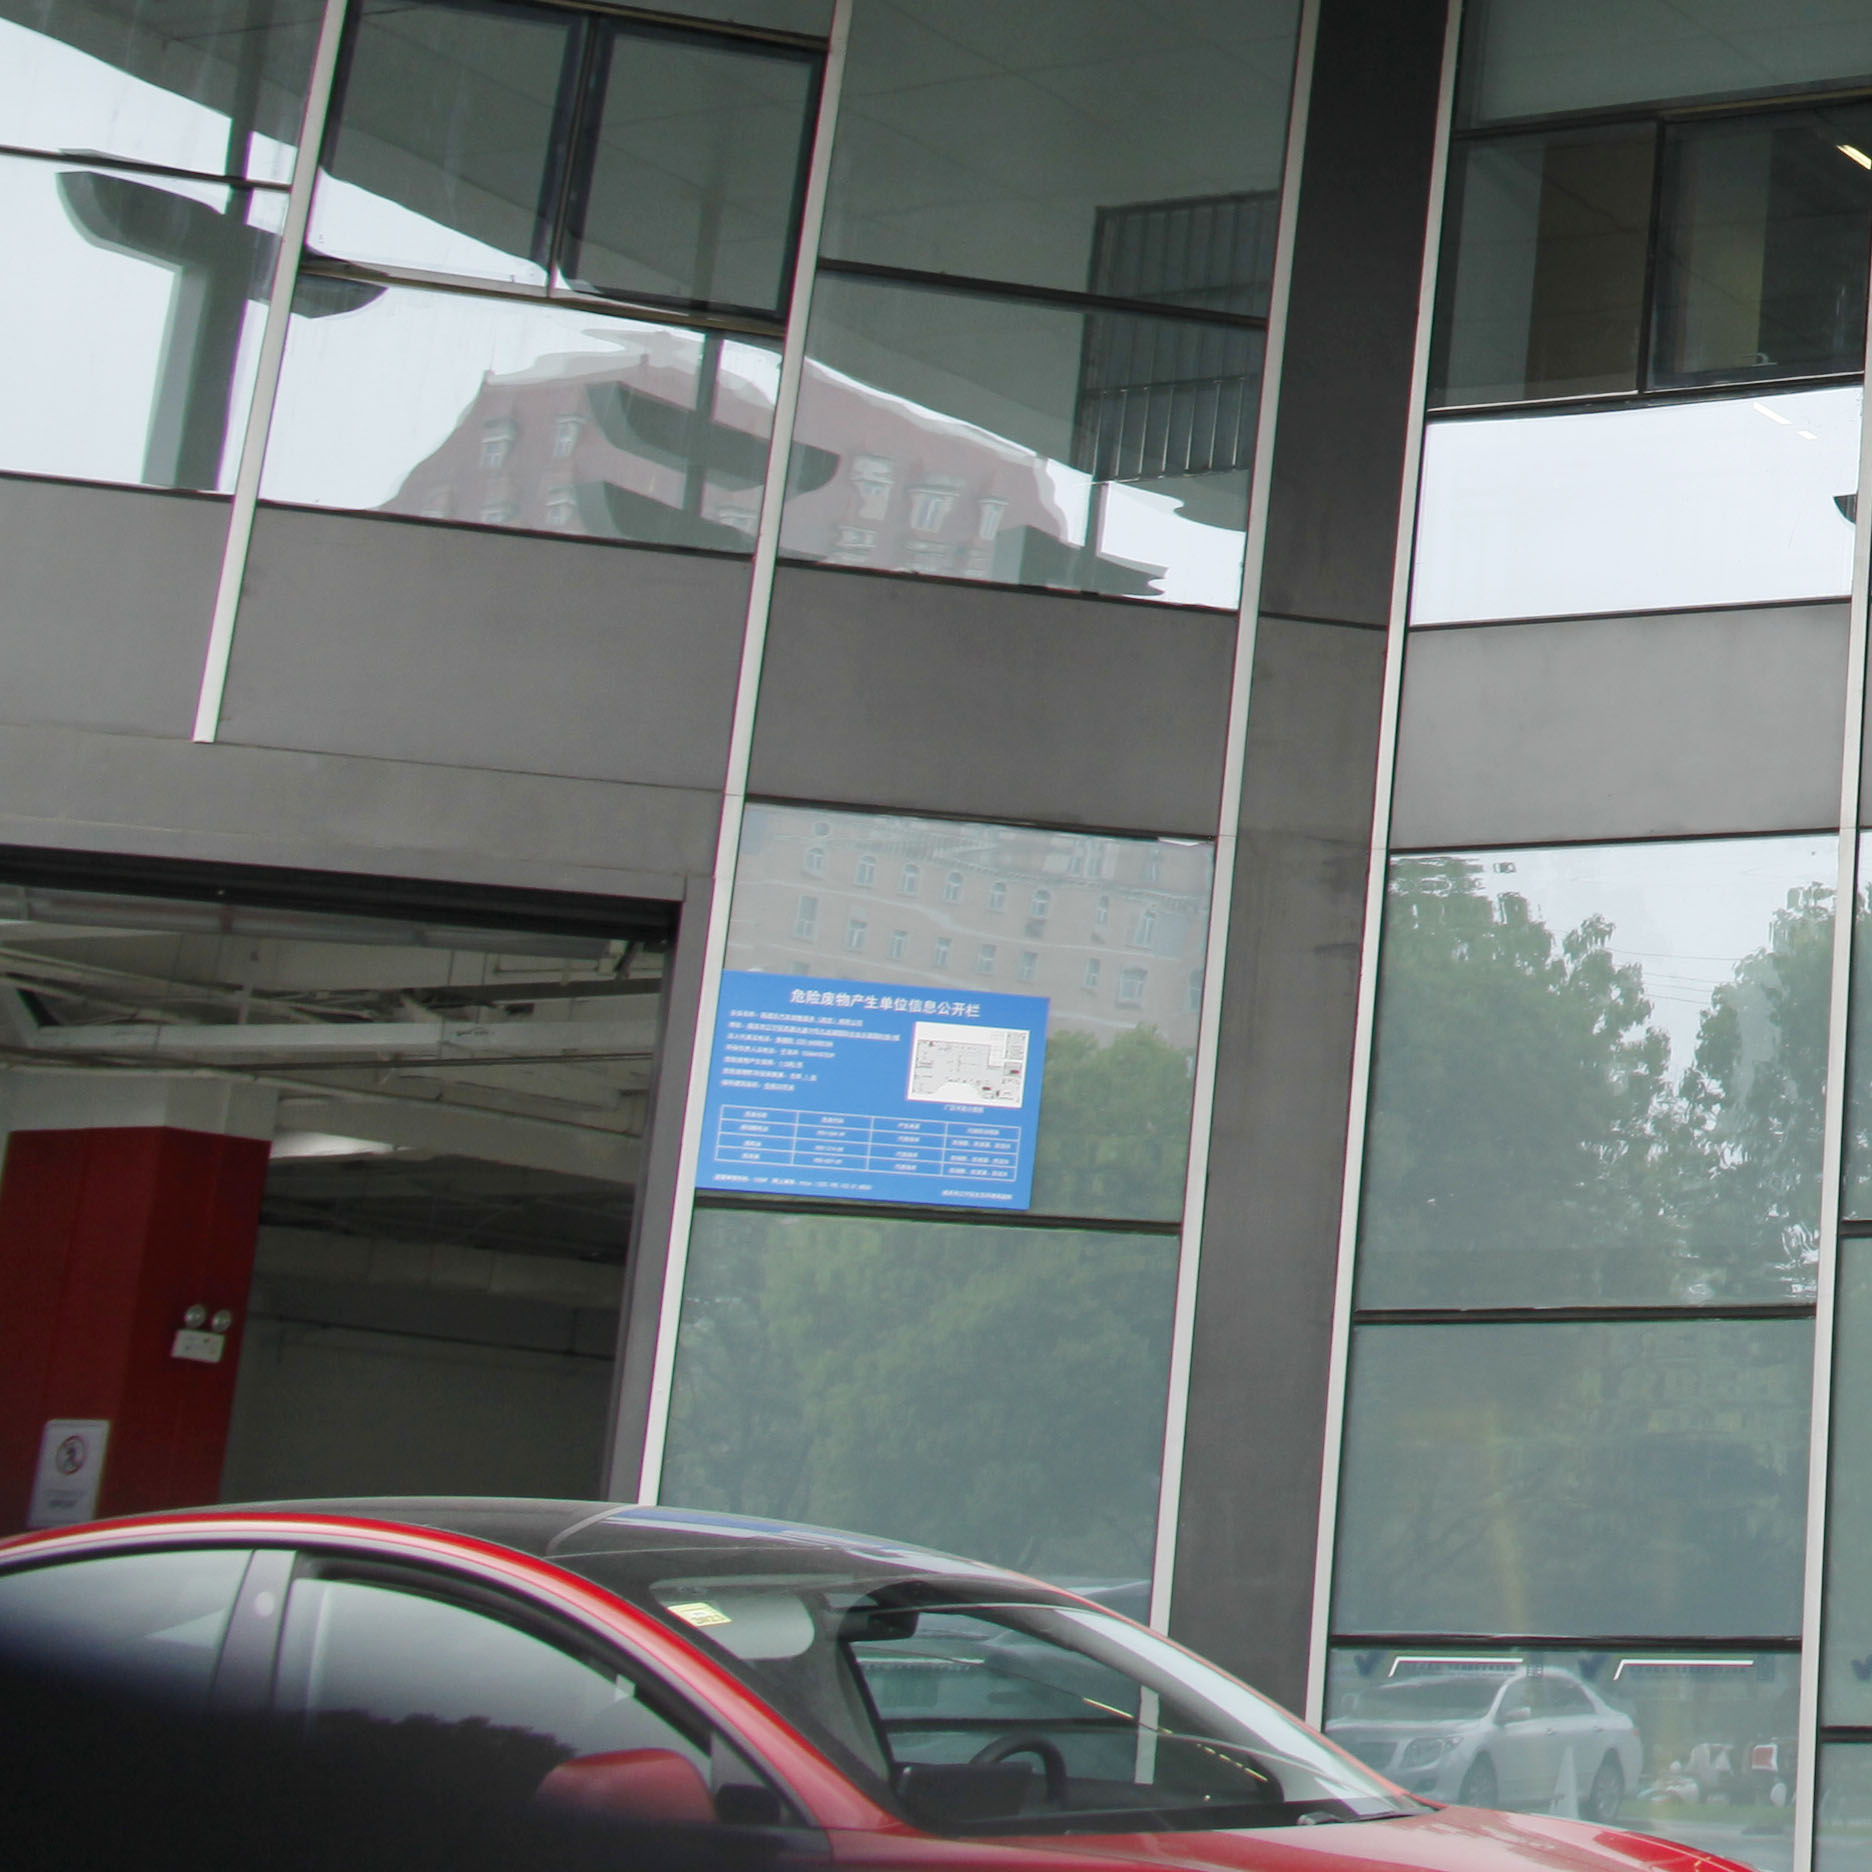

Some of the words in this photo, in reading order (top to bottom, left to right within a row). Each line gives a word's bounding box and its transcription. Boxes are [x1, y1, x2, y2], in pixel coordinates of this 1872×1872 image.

[790, 988, 982, 1018] 危险废物产生单位信息公开栏
